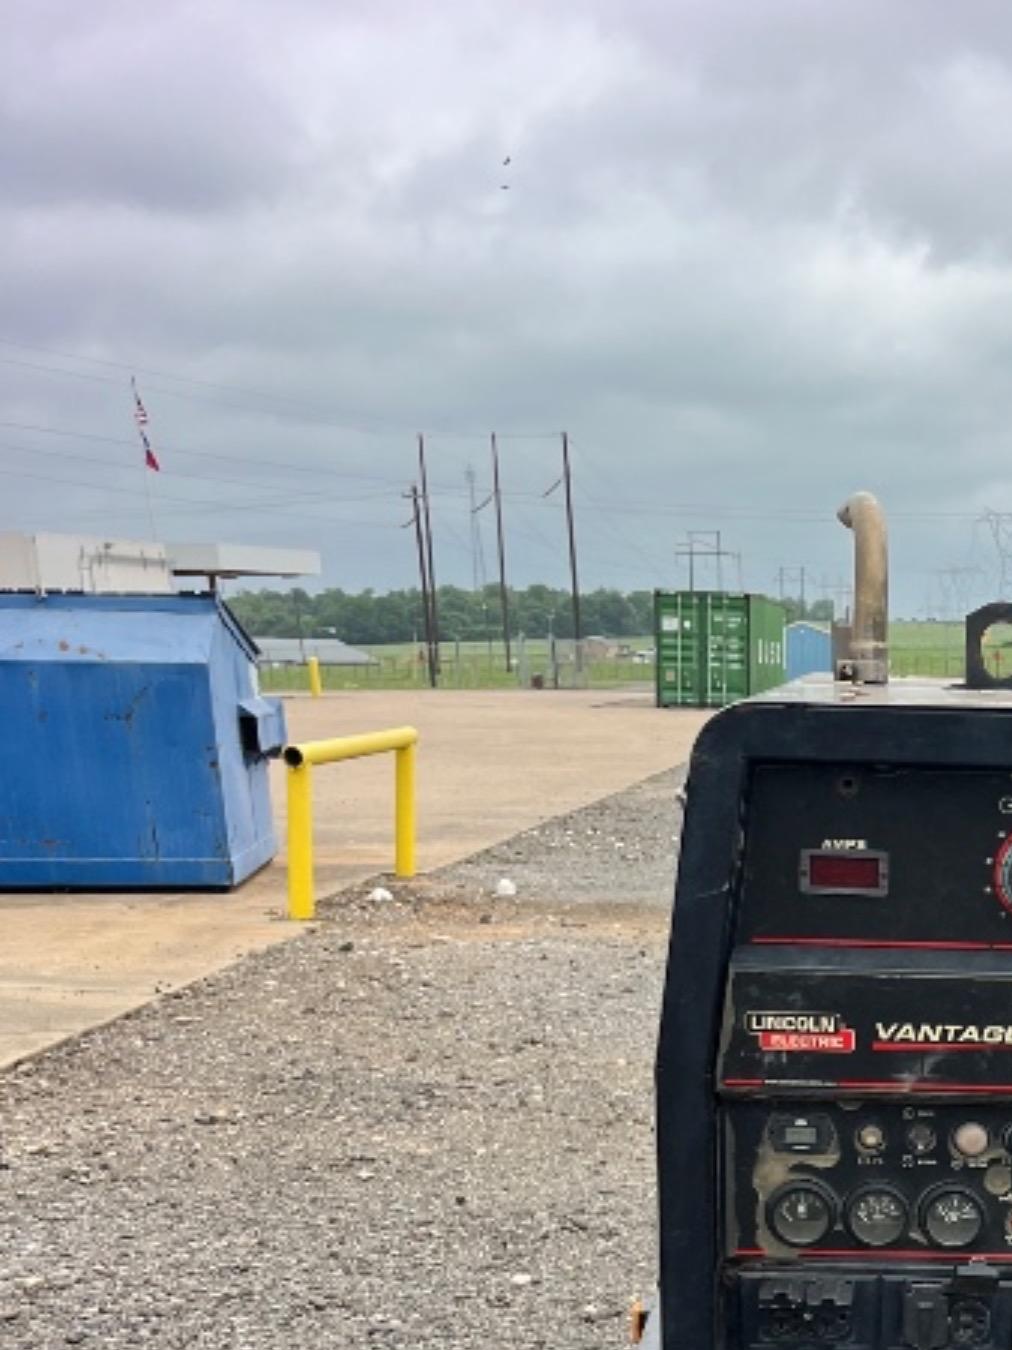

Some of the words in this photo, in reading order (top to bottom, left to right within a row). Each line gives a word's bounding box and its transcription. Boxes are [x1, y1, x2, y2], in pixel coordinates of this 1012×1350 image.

[821, 838, 868, 850] AMPS
[751, 1014, 836, 1033] LINCOLN
[769, 1034, 845, 1048] ELECTRIC
